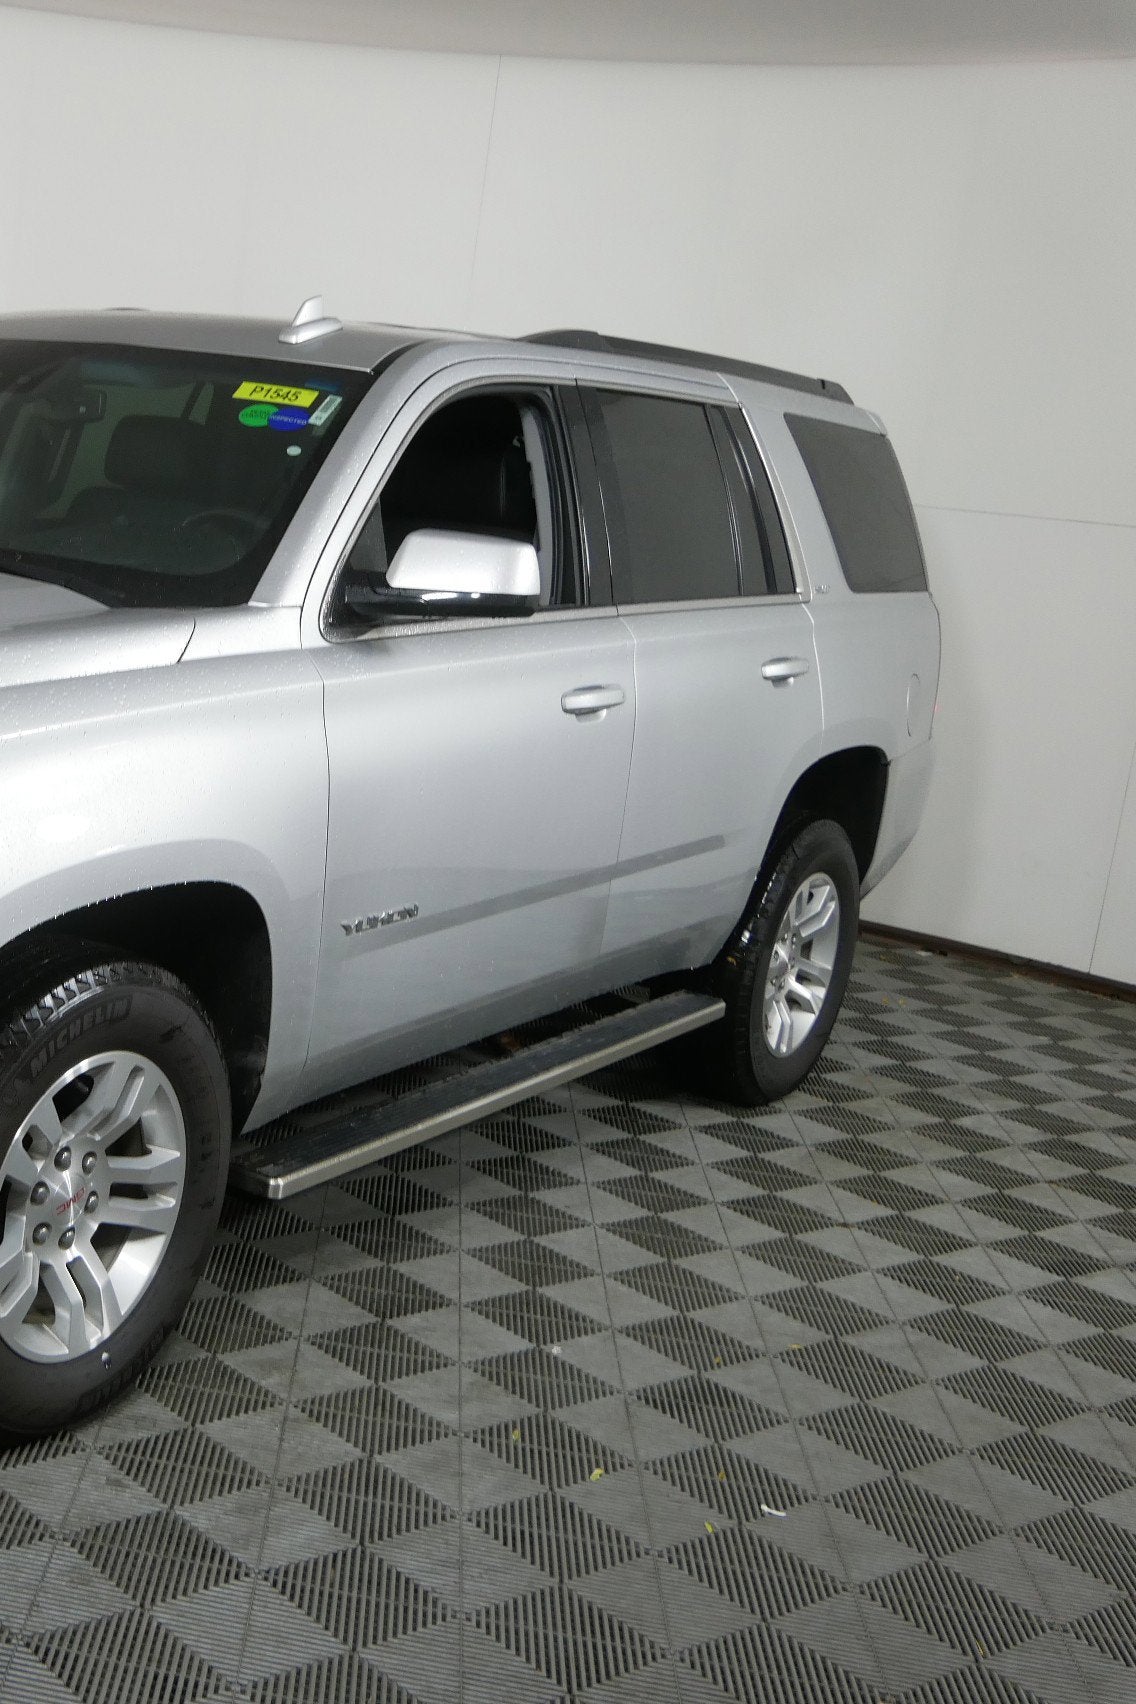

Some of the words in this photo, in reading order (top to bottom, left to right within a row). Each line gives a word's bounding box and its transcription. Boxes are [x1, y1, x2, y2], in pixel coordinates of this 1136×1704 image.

[250, 385, 301, 402] P1545
[340, 903, 419, 936] YUKON
[30, 994, 132, 1078] MICHELIN
